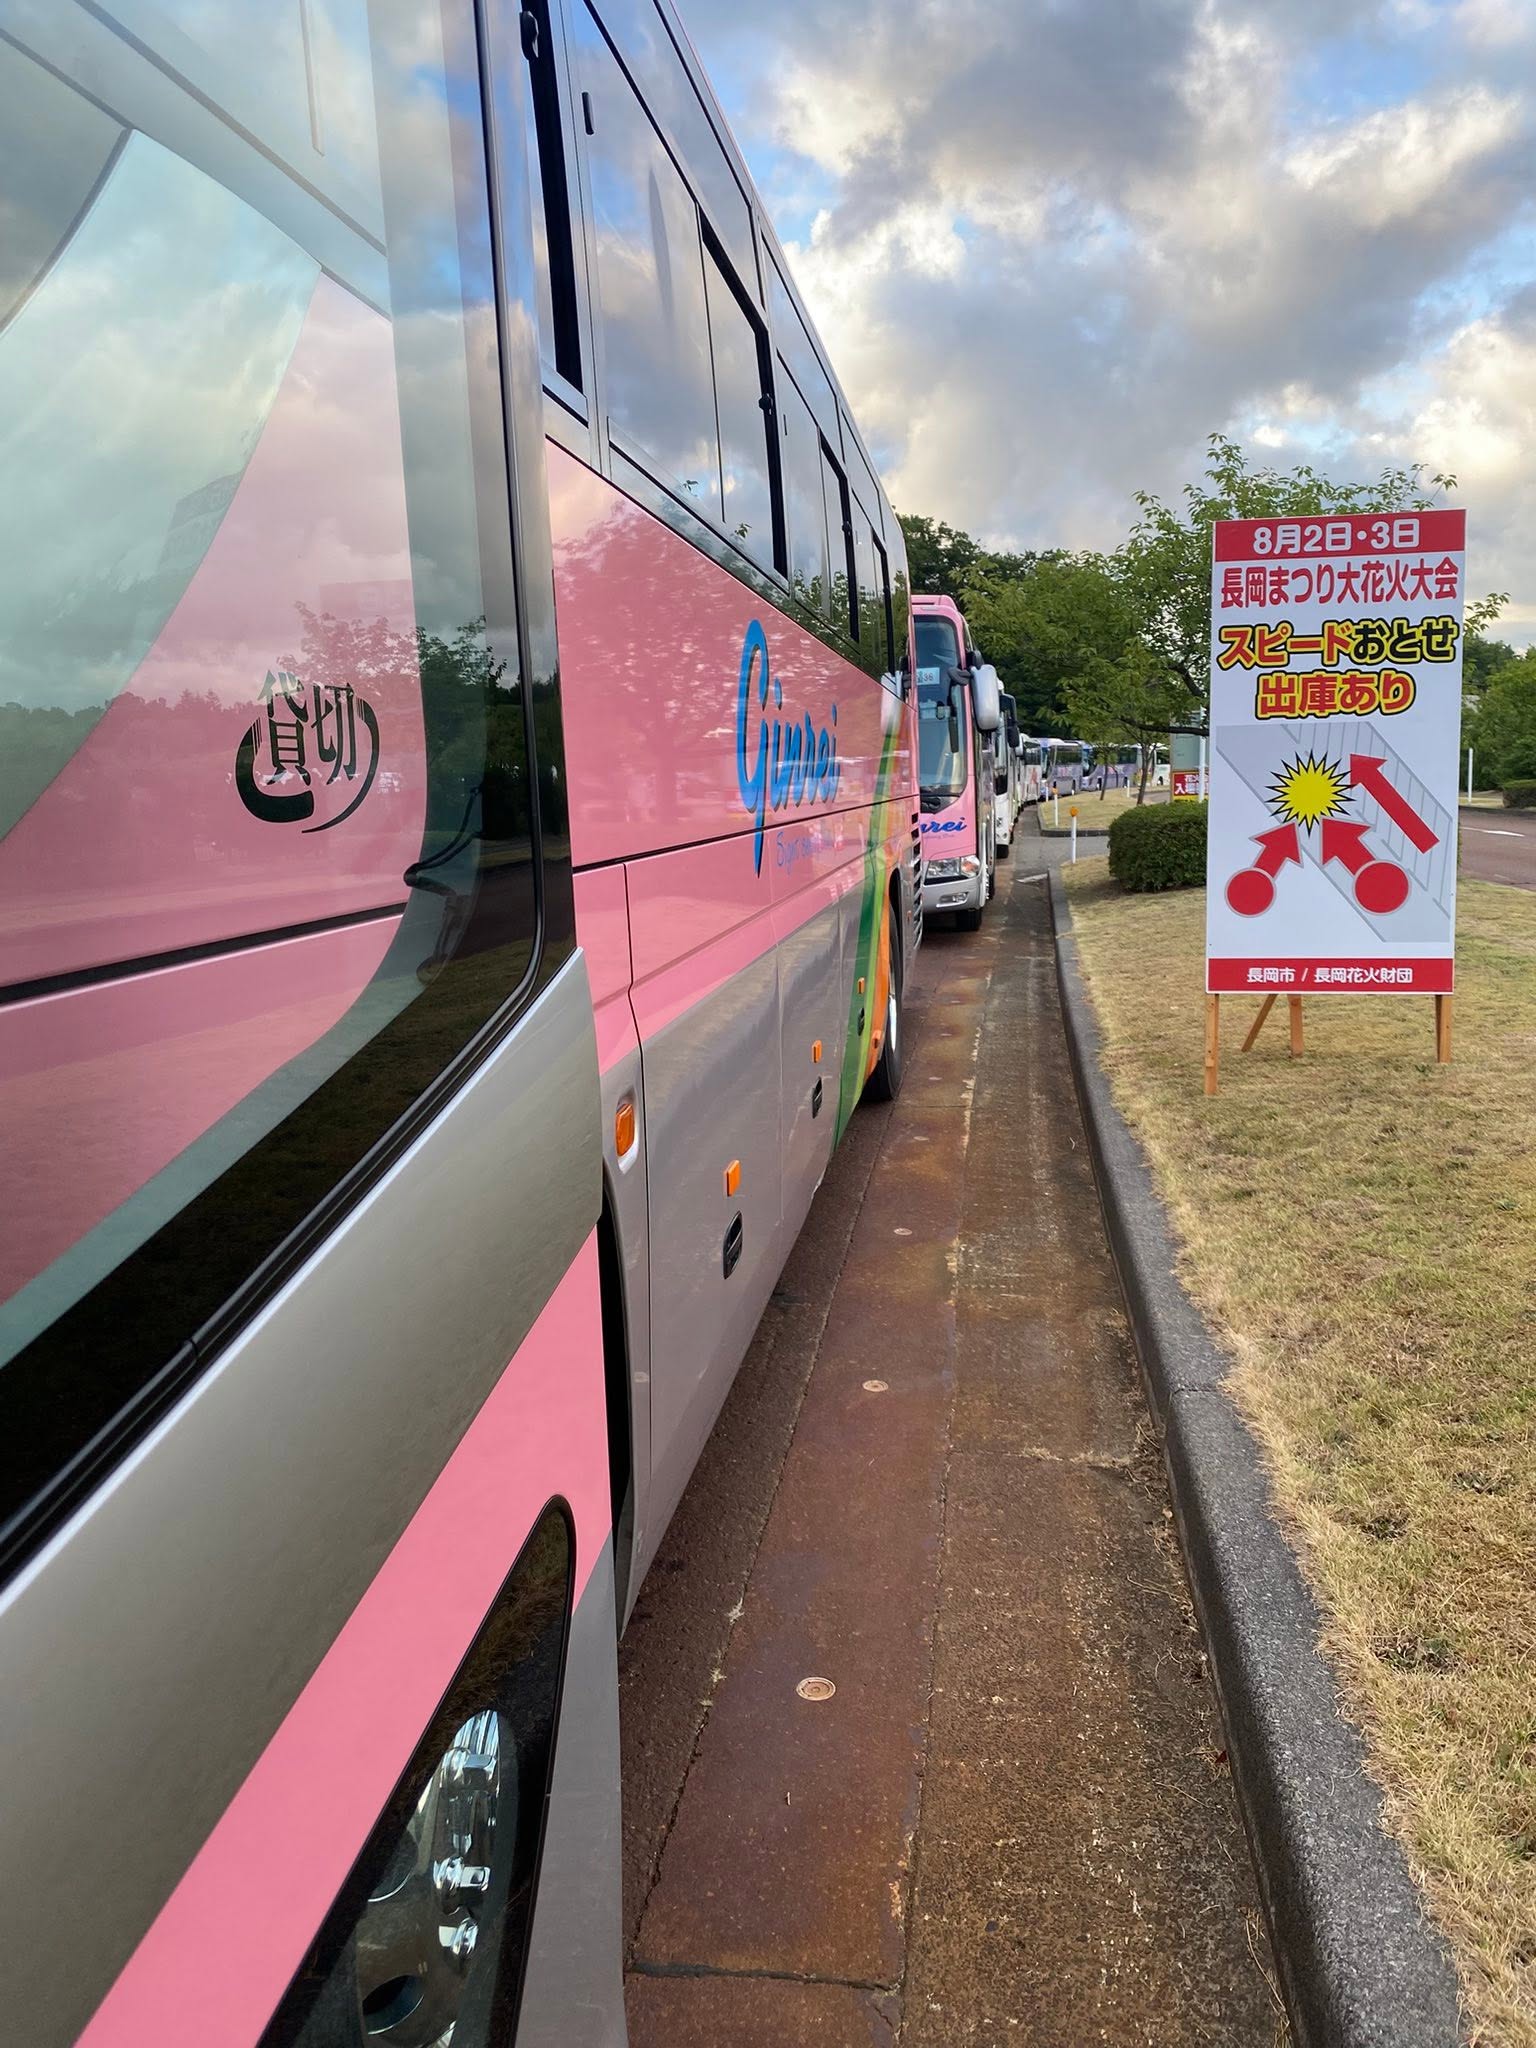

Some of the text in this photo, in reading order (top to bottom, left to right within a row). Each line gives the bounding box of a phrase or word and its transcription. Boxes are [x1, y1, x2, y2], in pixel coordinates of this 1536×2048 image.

[1221, 556, 1459, 609] 長岡まつり大花火大会
[1216, 615, 1461, 671] スピードおとせ
[1255, 668, 1417, 720] 出庫あり
[256, 669, 358, 787] 貸切
[1246, 967, 1296, 983] 長岡市
[1314, 967, 1413, 984] 長岡花火財団
